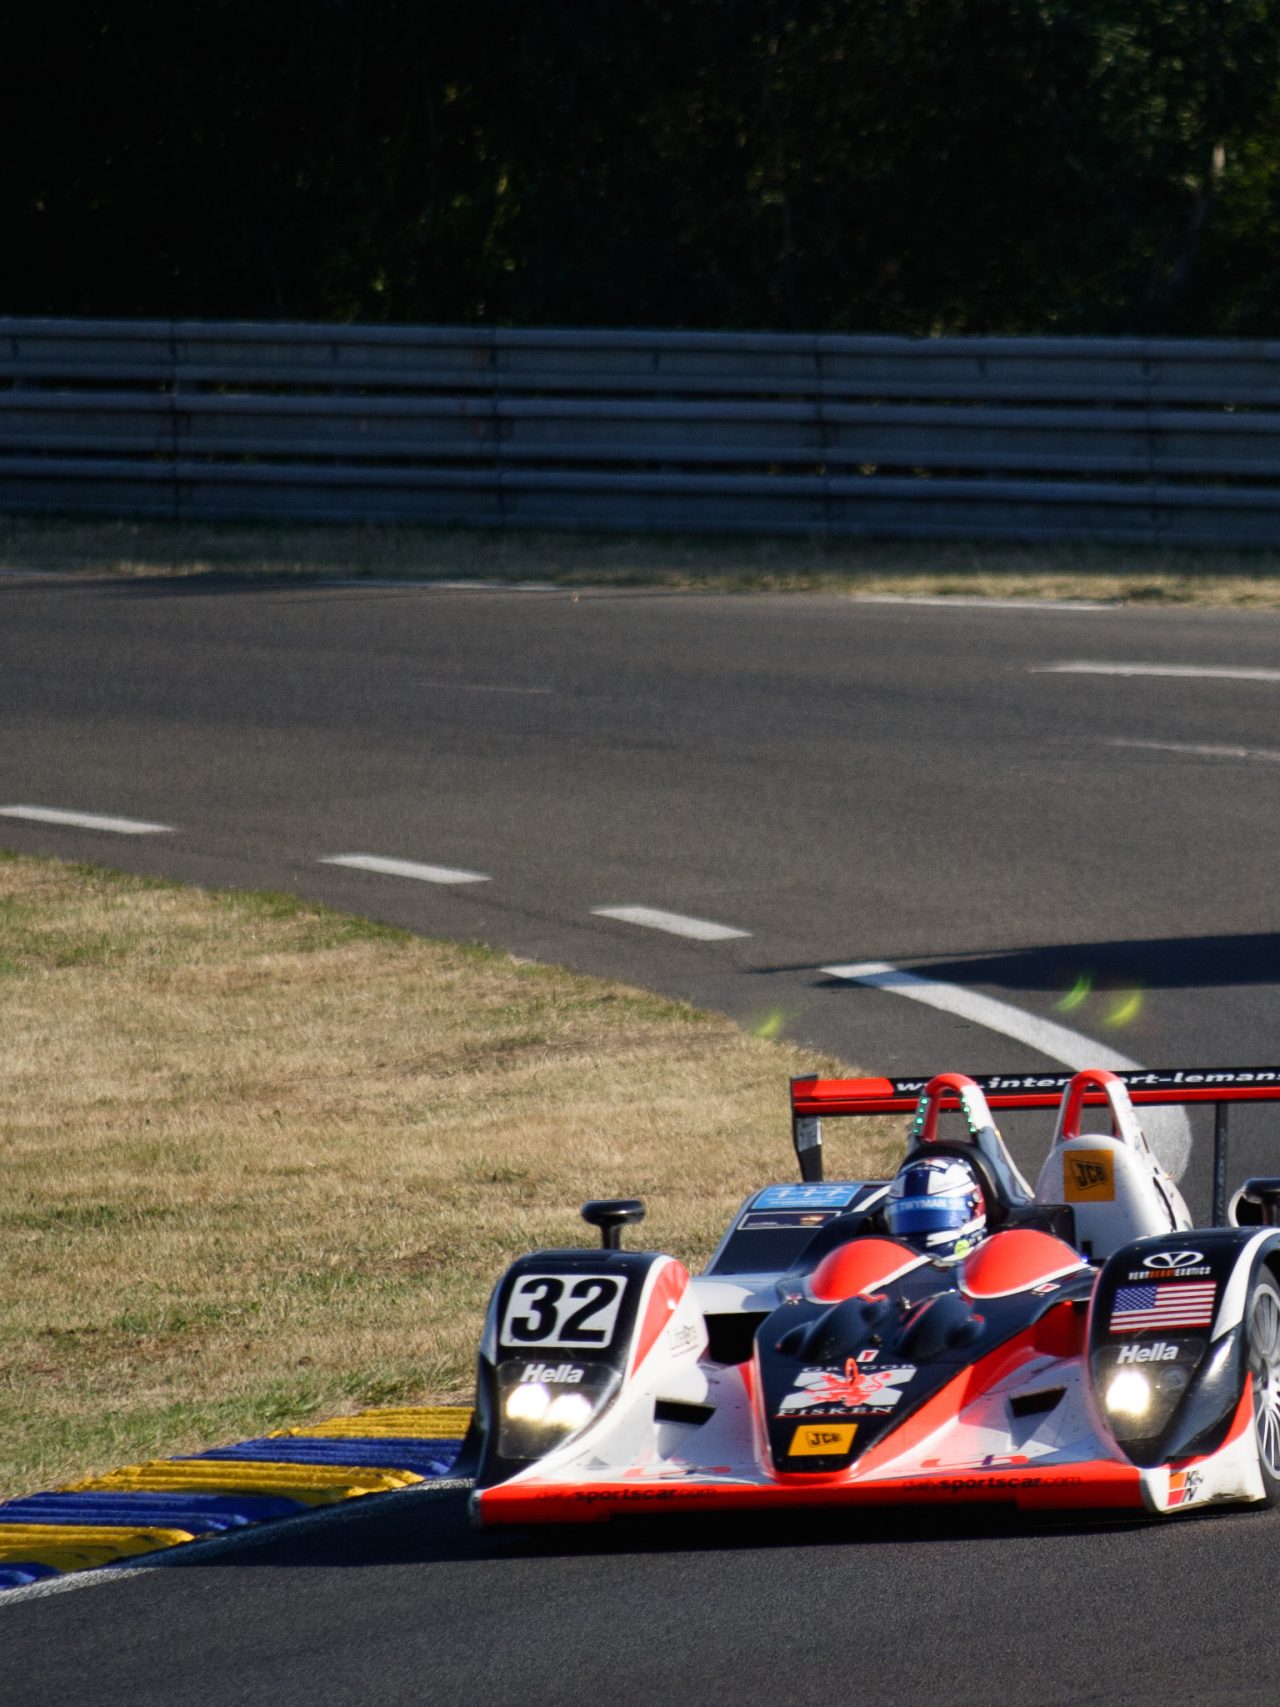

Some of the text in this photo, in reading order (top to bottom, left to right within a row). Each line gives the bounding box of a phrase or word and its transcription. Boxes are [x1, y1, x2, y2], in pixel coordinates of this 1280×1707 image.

[1076, 1162, 1107, 1187] JCB
[510, 1277, 619, 1342] 32
[1116, 1342, 1179, 1364] Hella
[520, 1363, 585, 1384] Hella
[801, 1364, 917, 1373] GRGOR
[776, 1406, 893, 1418] FISKEN
